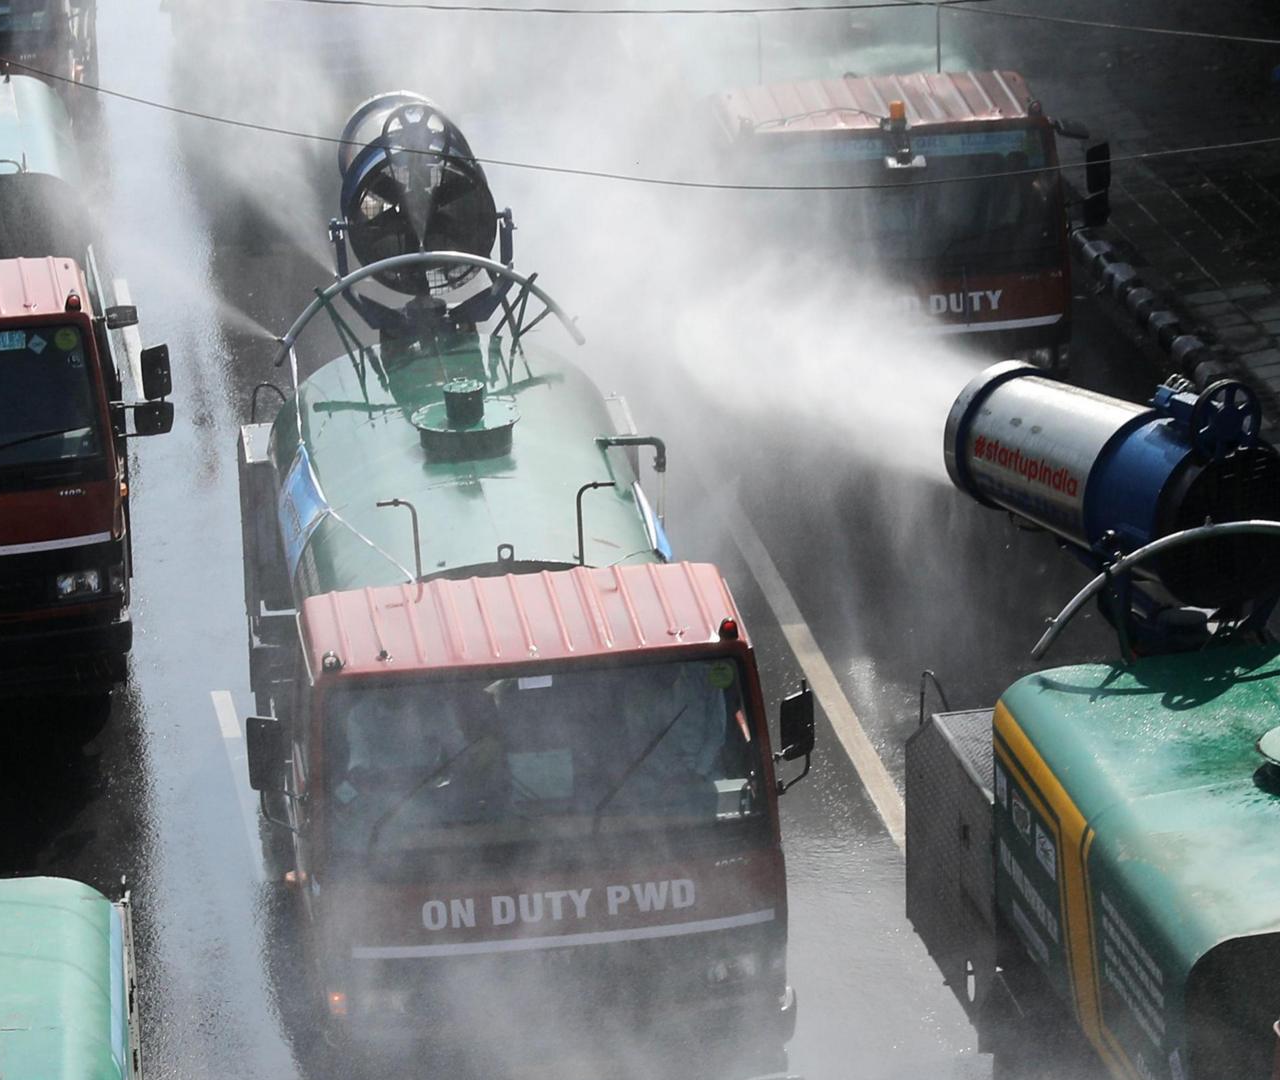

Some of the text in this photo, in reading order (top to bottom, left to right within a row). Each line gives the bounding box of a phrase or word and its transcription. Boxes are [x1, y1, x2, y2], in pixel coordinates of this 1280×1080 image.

[929, 290, 1002, 315] DUTY
[974, 435, 1079, 497] #startupindia
[422, 879, 696, 931] ON DUTY PWD
